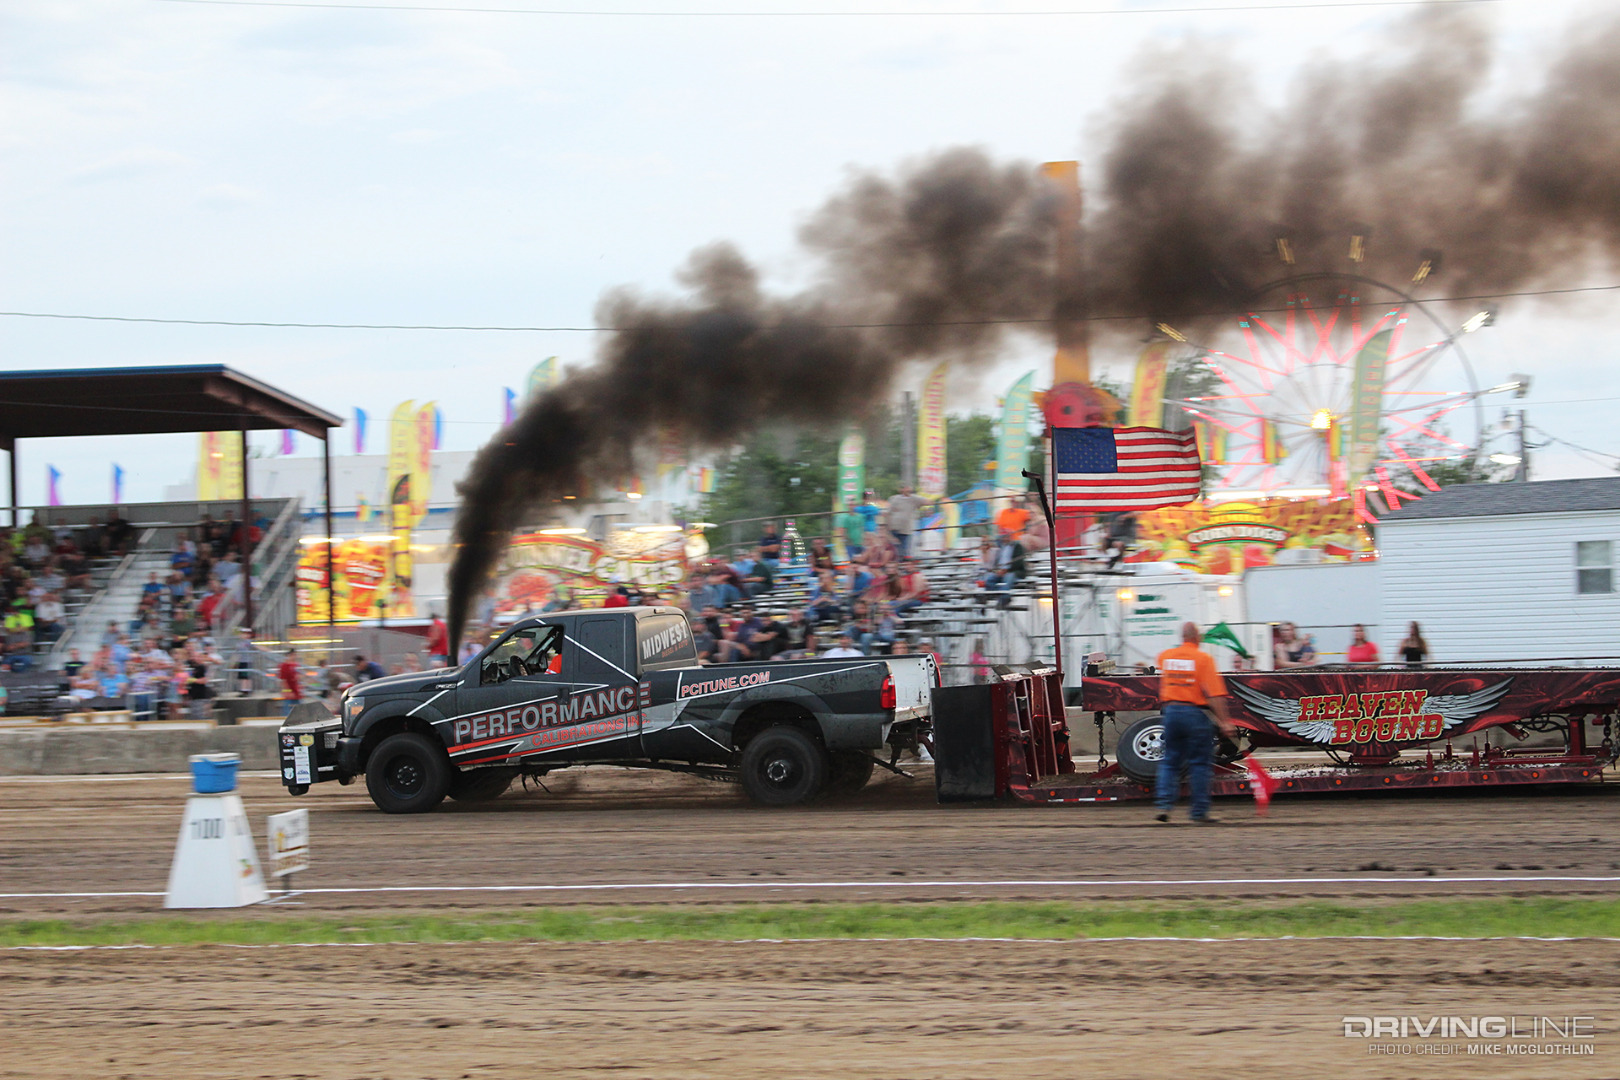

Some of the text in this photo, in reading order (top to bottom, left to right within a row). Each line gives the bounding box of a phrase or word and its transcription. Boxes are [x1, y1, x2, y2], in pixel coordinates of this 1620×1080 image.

[642, 620, 687, 659] MIDWEST
[681, 671, 770, 697] PCITUNE.COM
[454, 681, 652, 745] PERFORMANCE
[1297, 689, 1428, 722] HEAVEN
[532, 717, 625, 746] CALIBRATIONS
[1329, 713, 1444, 745] BOUND
